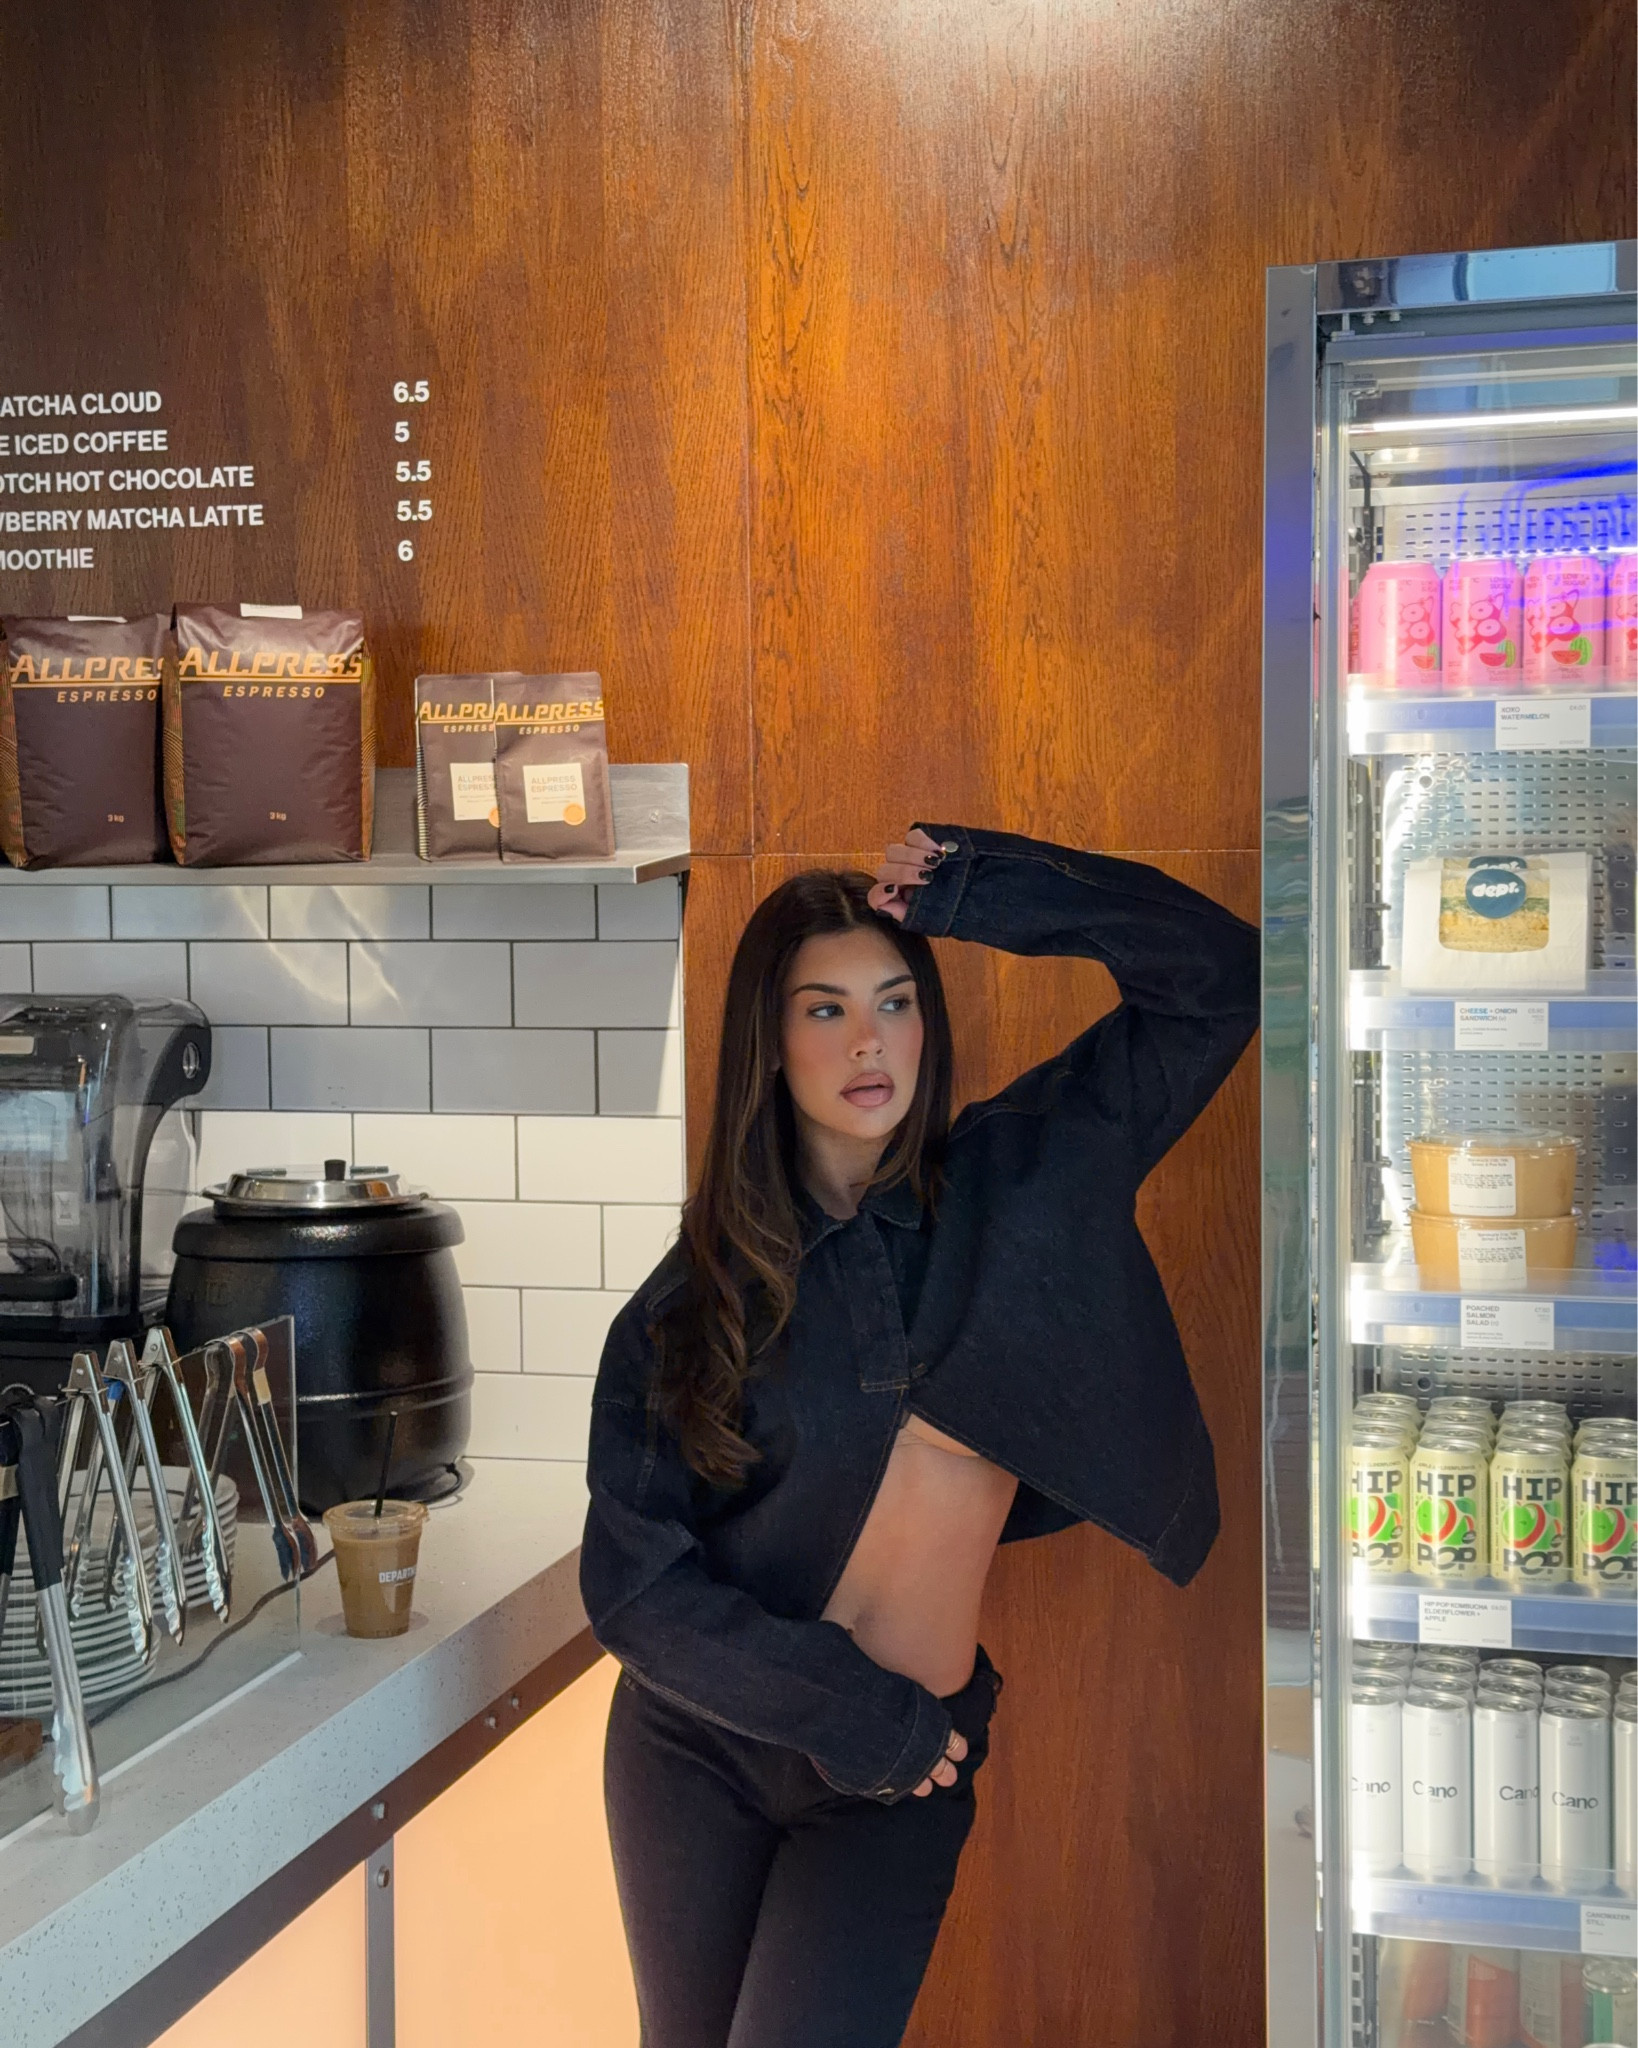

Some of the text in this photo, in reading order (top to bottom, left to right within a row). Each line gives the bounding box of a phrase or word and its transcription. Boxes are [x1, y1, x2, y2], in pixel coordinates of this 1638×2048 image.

[394, 381, 430, 403] 6.5
[0, 391, 162, 417] ATCHA CLOUD
[15, 433, 69, 456] ICED
[74, 430, 168, 453] COFFEE
[395, 422, 410, 443] 5
[56, 470, 104, 493] HOT
[109, 466, 254, 491] CHOCOLATE
[396, 461, 431, 482] 5.5
[0, 505, 264, 532] BERRY MATCHA LATTE
[397, 500, 432, 521] 5.5
[398, 540, 413, 562] 6
[178, 647, 362, 678] ALLPRESS
[57, 689, 157, 703] ESPRESSO
[223, 685, 325, 699] ESPRESSO
[495, 700, 604, 721] ALLPRESS
[519, 724, 580, 736] ESPRESSO
[531, 775, 576, 784] ALLPRESS
[531, 784, 578, 793] ESPRESSO
[1417, 1470, 1476, 1497] HIP
[1503, 1475, 1562, 1501] HIP
[1418, 1543, 1477, 1570] POP
[1504, 1548, 1564, 1576] POP
[1352, 1777, 1392, 1794] no
[1412, 1780, 1458, 1798] Cano
[1552, 1791, 1599, 1810] Cano
